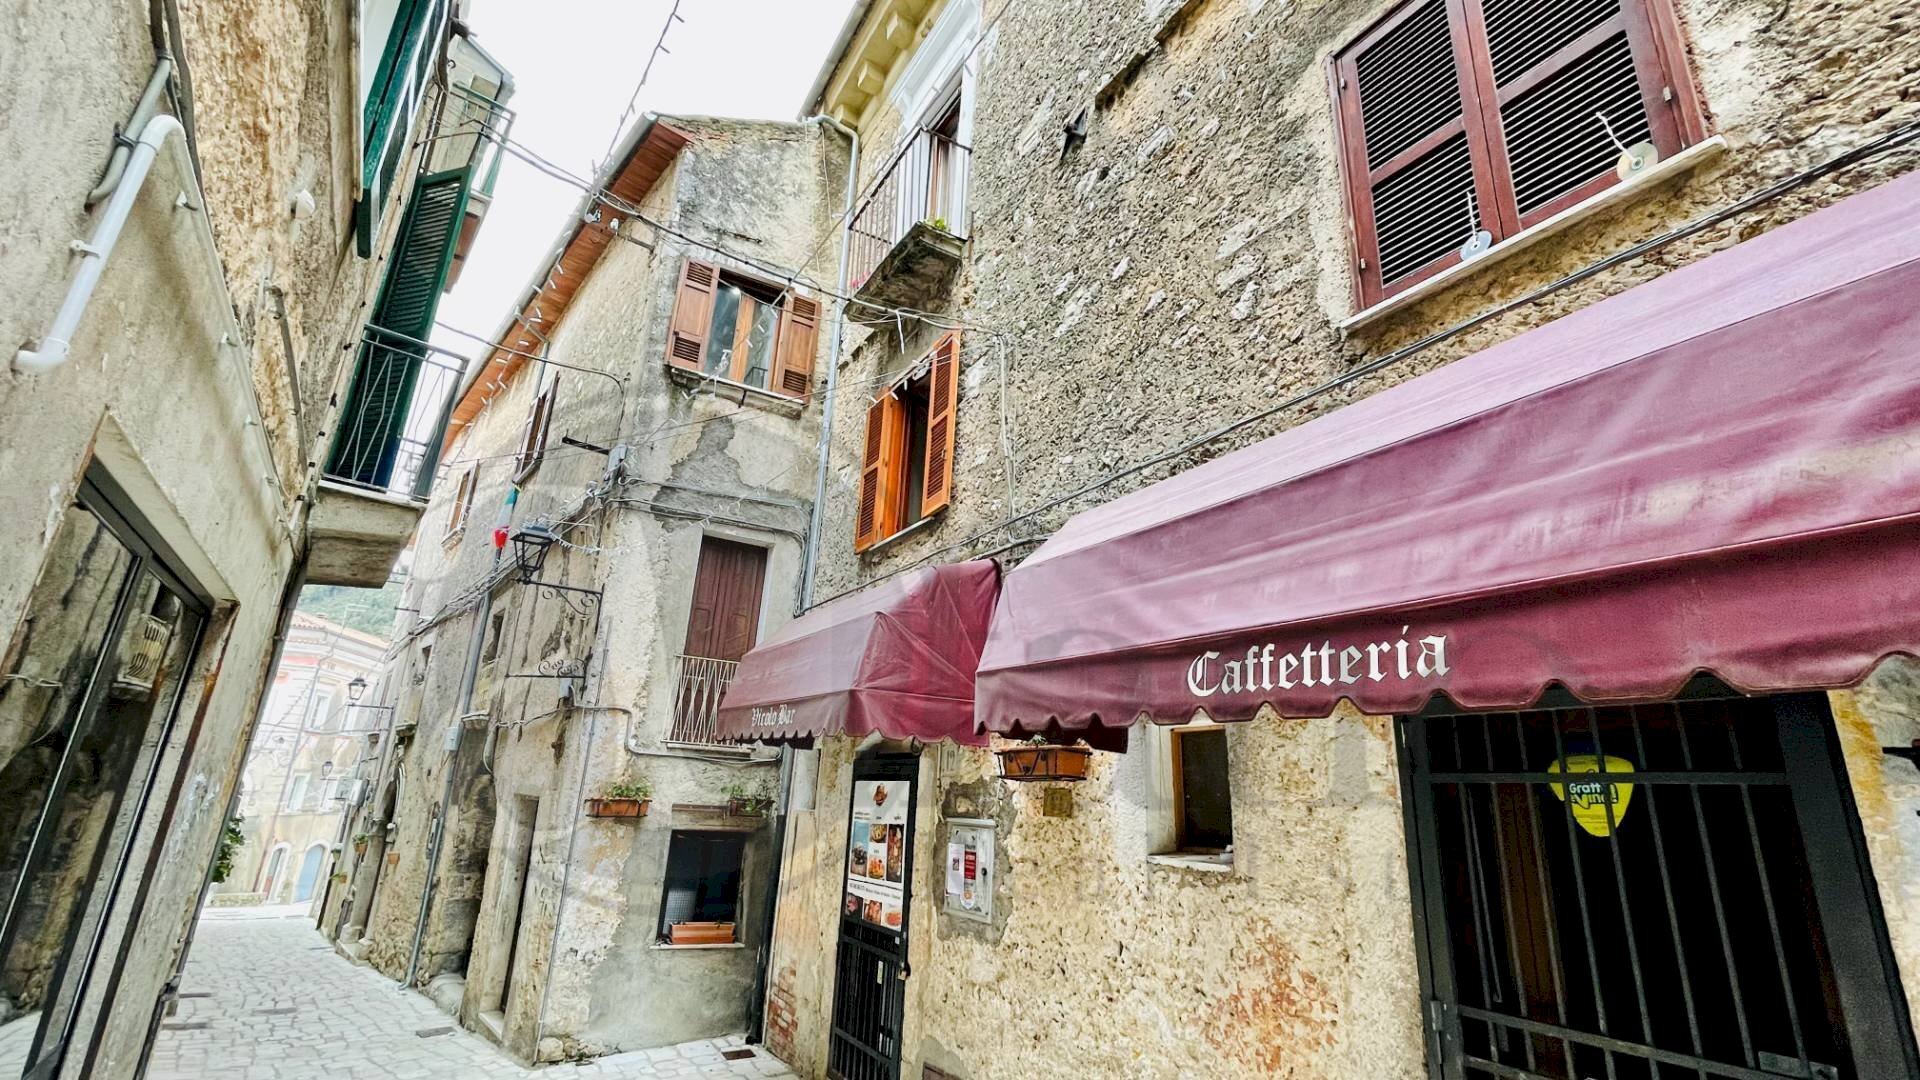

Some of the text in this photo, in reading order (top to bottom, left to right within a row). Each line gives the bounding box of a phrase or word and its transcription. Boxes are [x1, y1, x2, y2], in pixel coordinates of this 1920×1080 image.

[1187, 625, 1451, 697] Caffetteria
[751, 704, 796, 728] Vicolo Bar
[1569, 783, 1604, 794] Gratt
